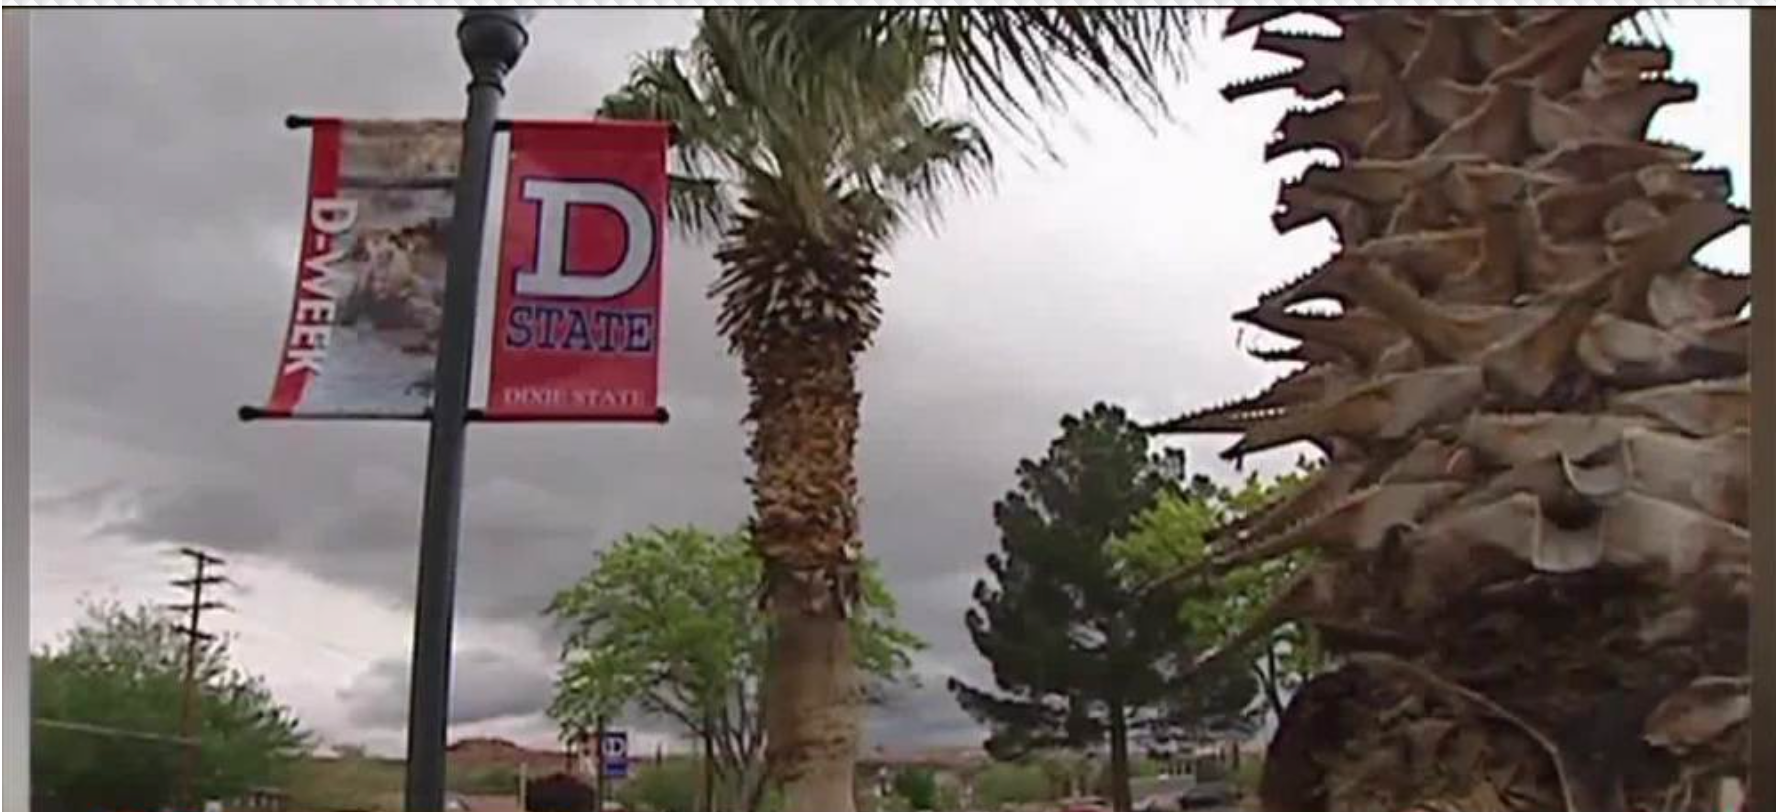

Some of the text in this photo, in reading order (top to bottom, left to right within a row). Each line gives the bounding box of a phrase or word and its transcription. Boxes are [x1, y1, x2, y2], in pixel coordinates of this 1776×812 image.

[514, 177, 658, 300] D
[283, 200, 358, 376] D-WEEK
[506, 306, 654, 353] STATE
[503, 387, 645, 406] DIXIE STATE
